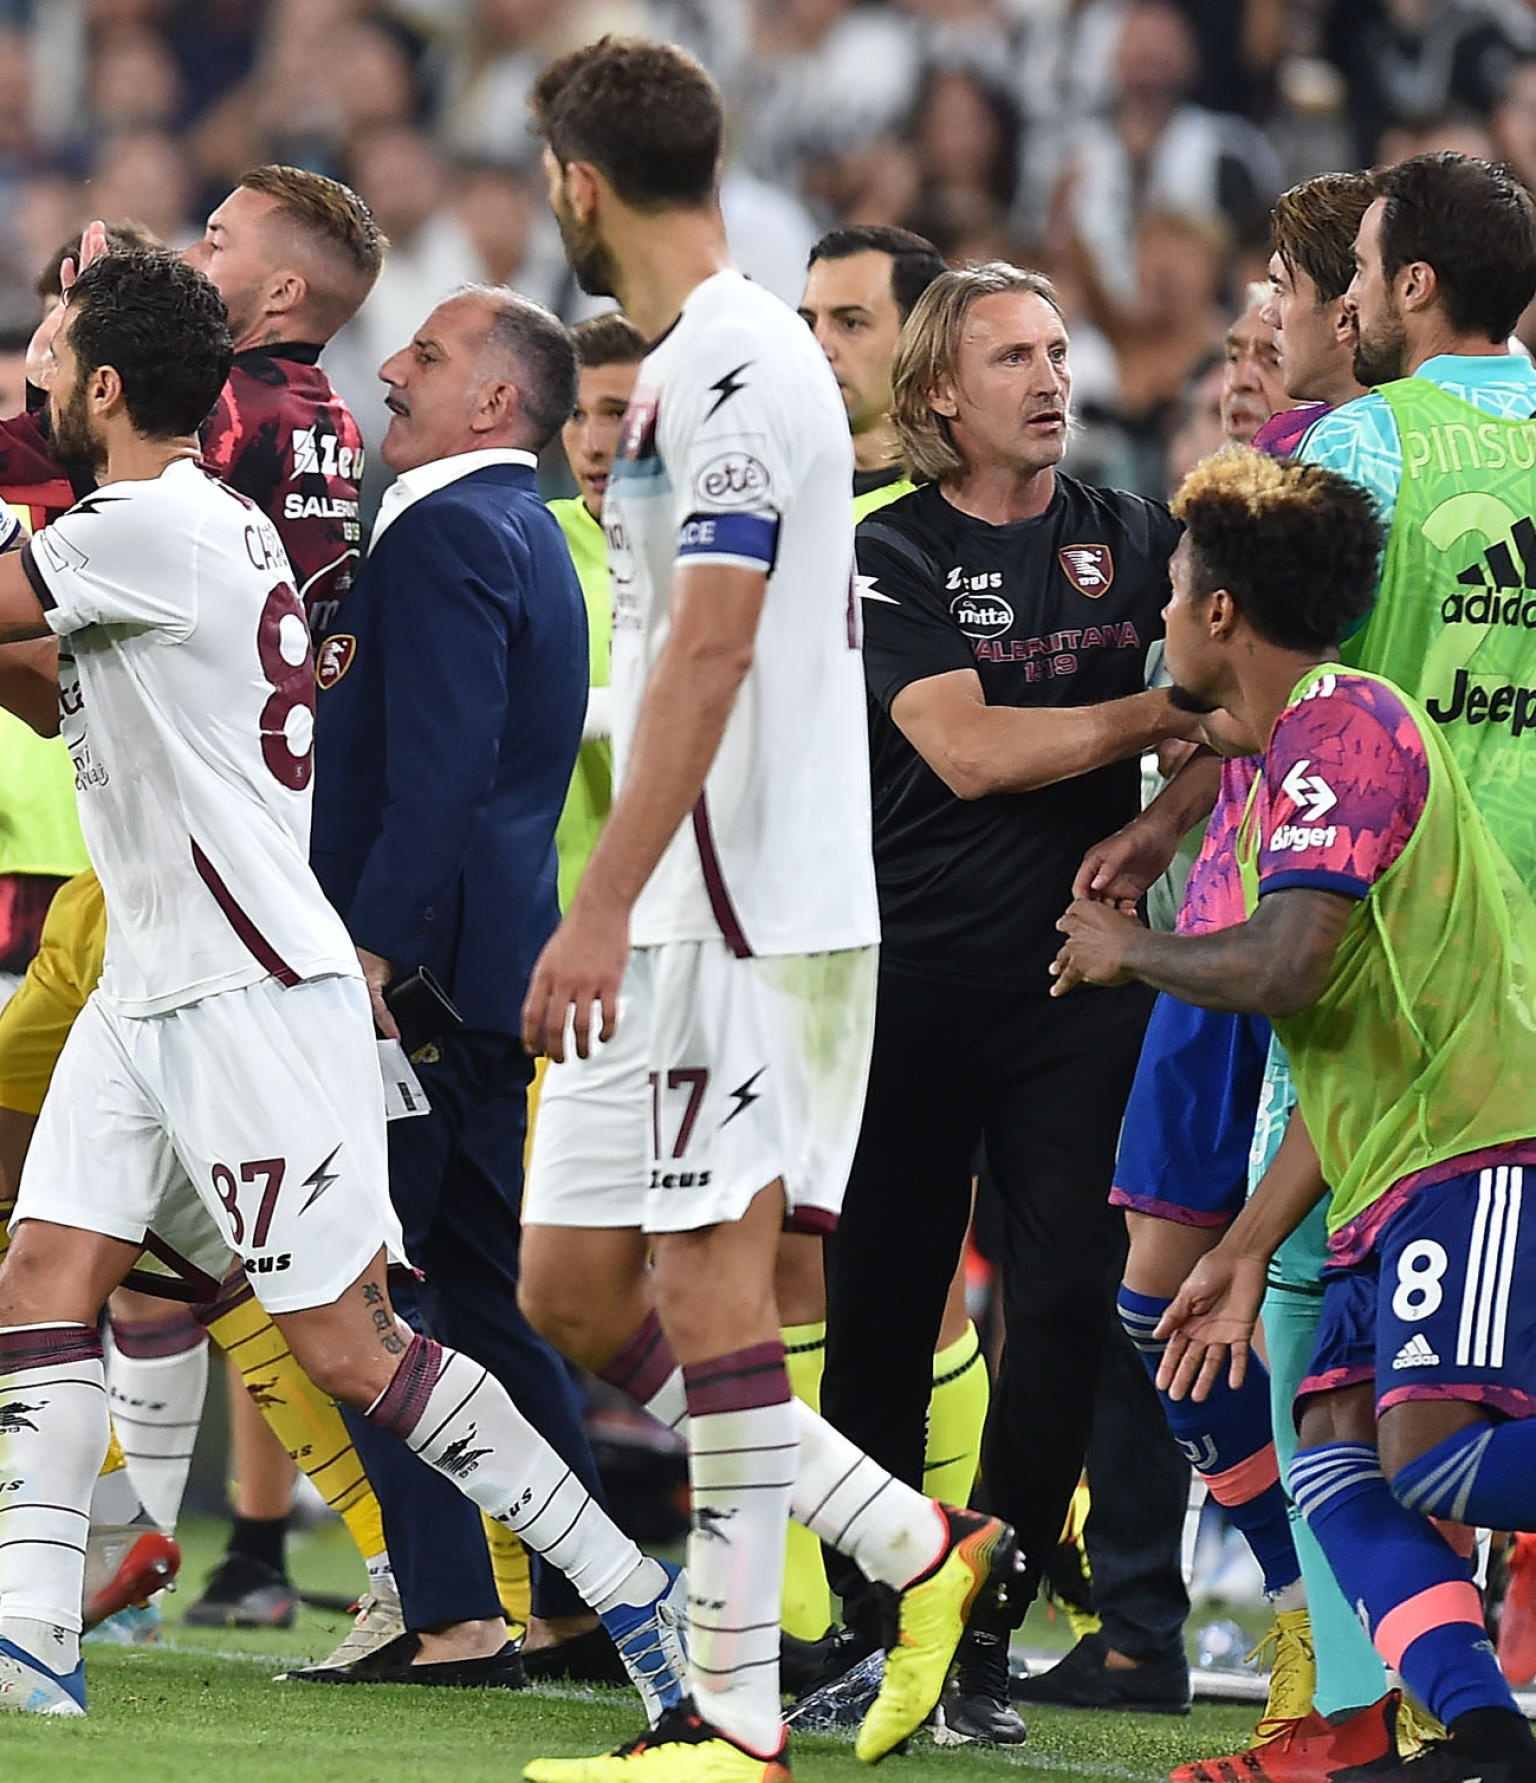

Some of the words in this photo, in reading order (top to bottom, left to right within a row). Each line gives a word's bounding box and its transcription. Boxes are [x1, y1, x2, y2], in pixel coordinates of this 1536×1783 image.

[648, 1067, 710, 1161] 17
[211, 1157, 287, 1249] 87
[1391, 1238, 1449, 1322] 8
[1391, 1354, 1441, 1371] adidas
